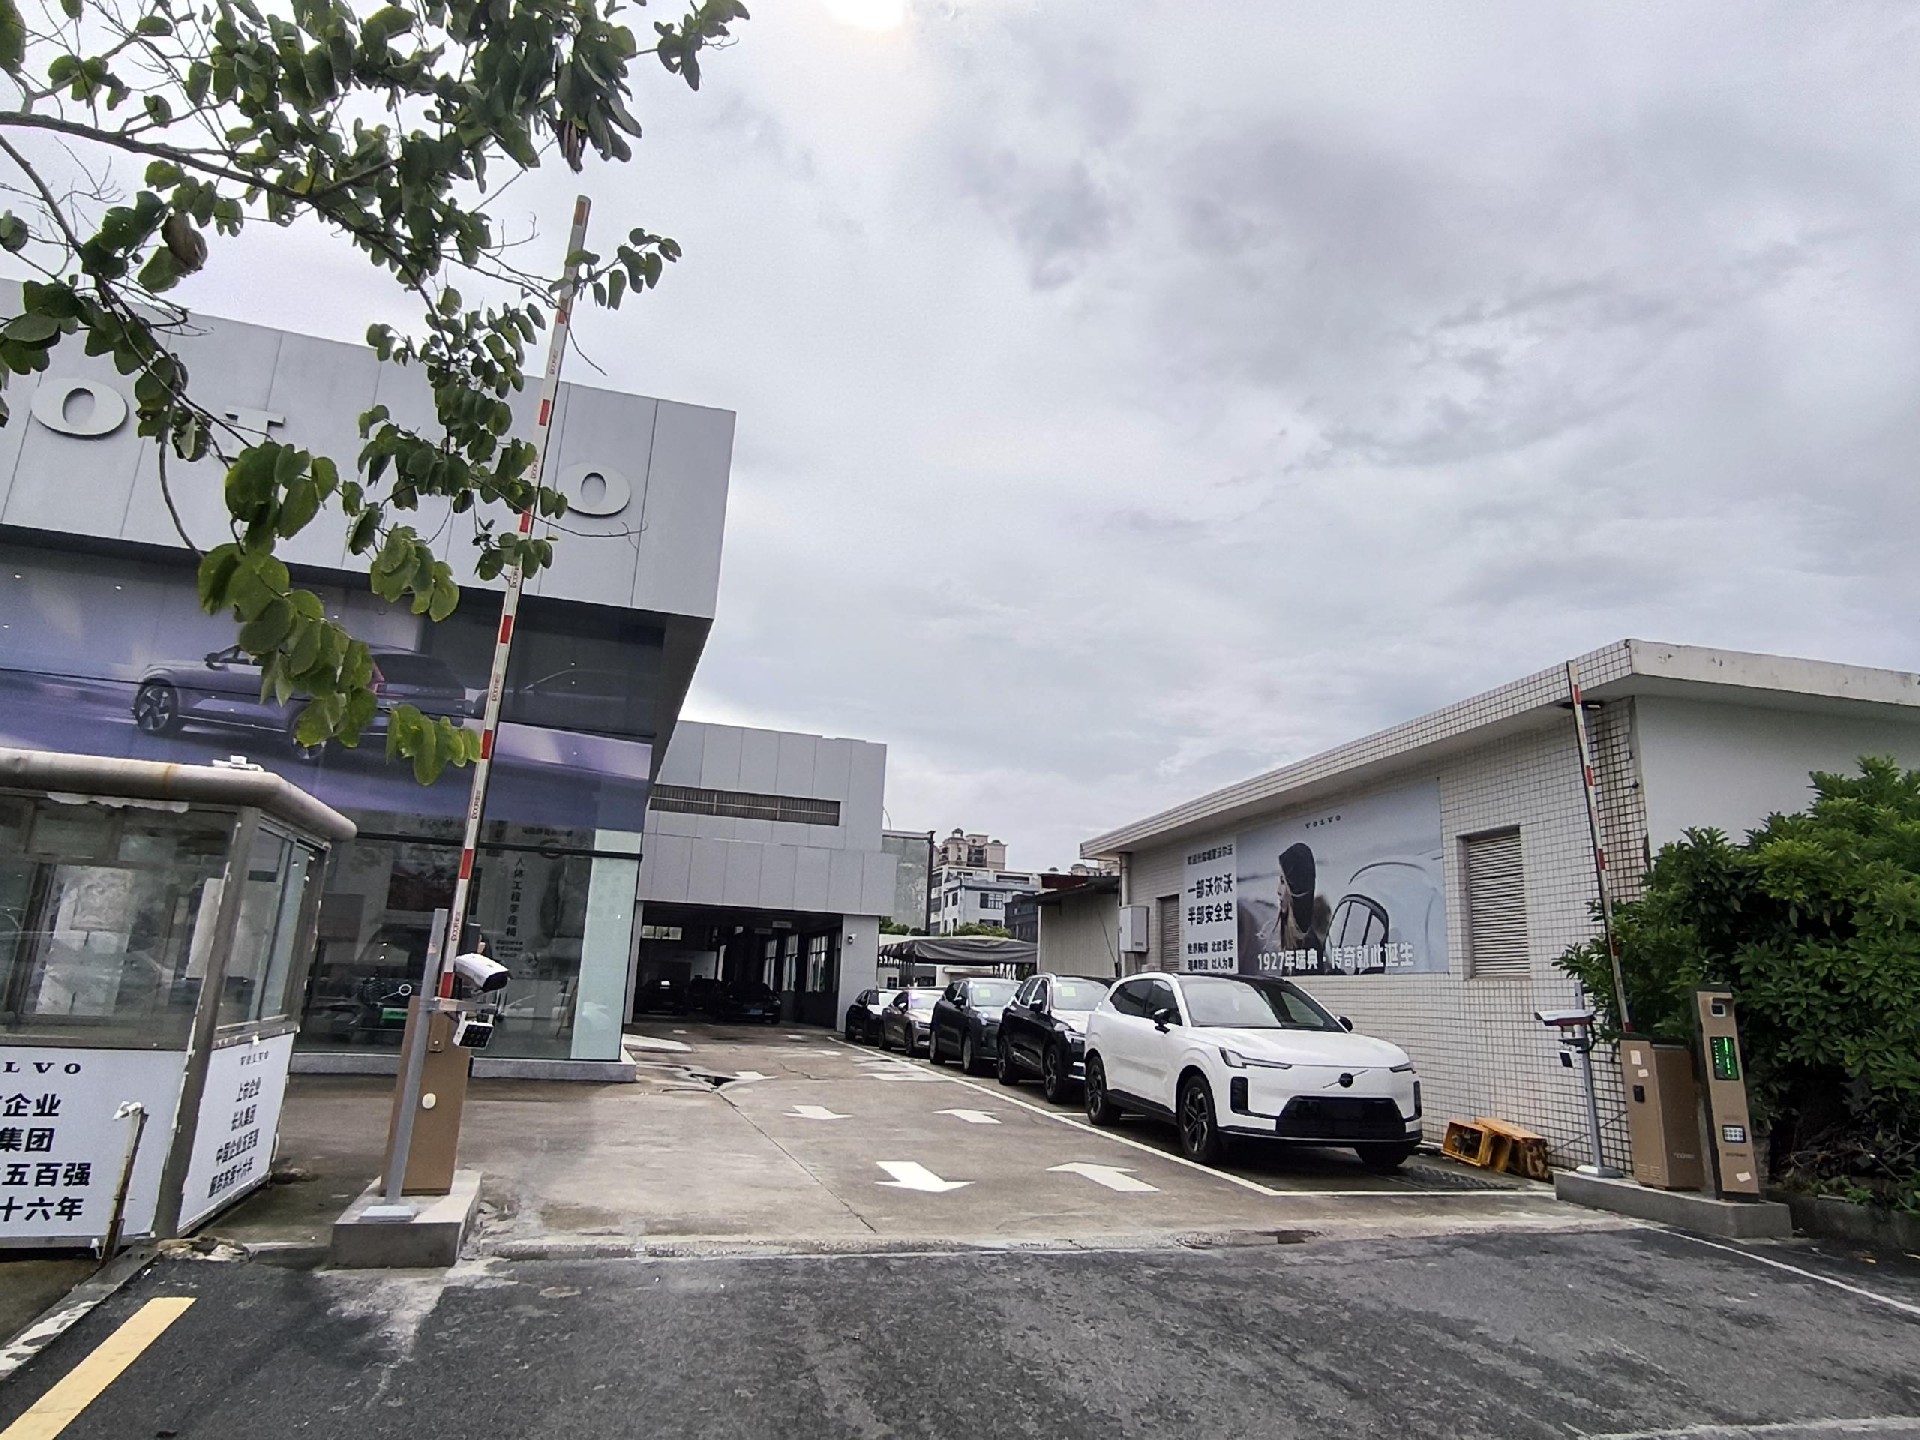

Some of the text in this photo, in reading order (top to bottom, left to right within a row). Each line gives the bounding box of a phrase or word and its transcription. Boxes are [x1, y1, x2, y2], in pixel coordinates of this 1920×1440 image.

[1187, 873, 1233, 899] 一部沃尔沃
[1187, 900, 1233, 926] 半部安全史
[0, 1092, 61, 1117] 企业
[0, 1162, 92, 1187] 五百强
[0, 1196, 84, 1222] 十六年
